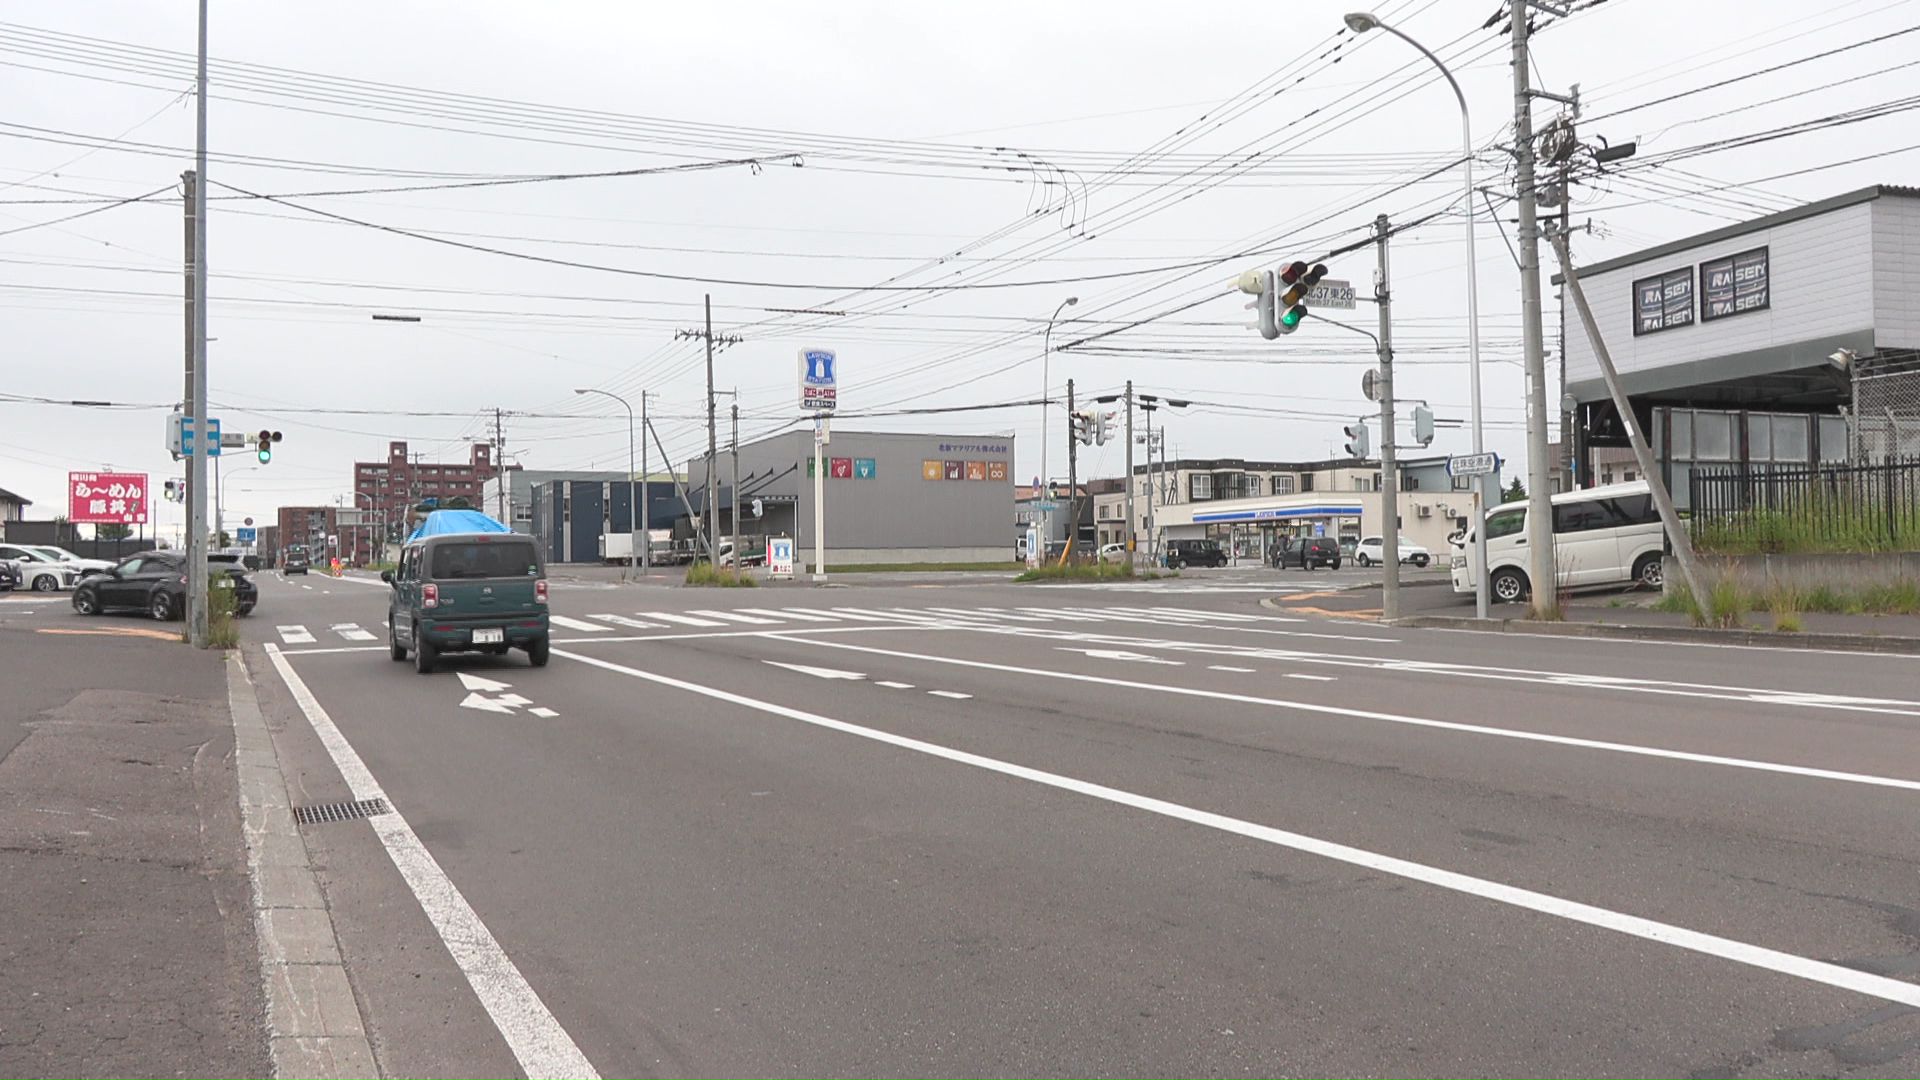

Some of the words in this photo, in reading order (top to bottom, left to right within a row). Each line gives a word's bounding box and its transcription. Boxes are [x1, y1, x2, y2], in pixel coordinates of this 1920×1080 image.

[1307, 287, 1353, 300] 北37東26
[1645, 280, 1691, 304] RASEN
[806, 352, 833, 361] LAWSON
[807, 376, 834, 384] STATION
[824, 389, 836, 399] ATM
